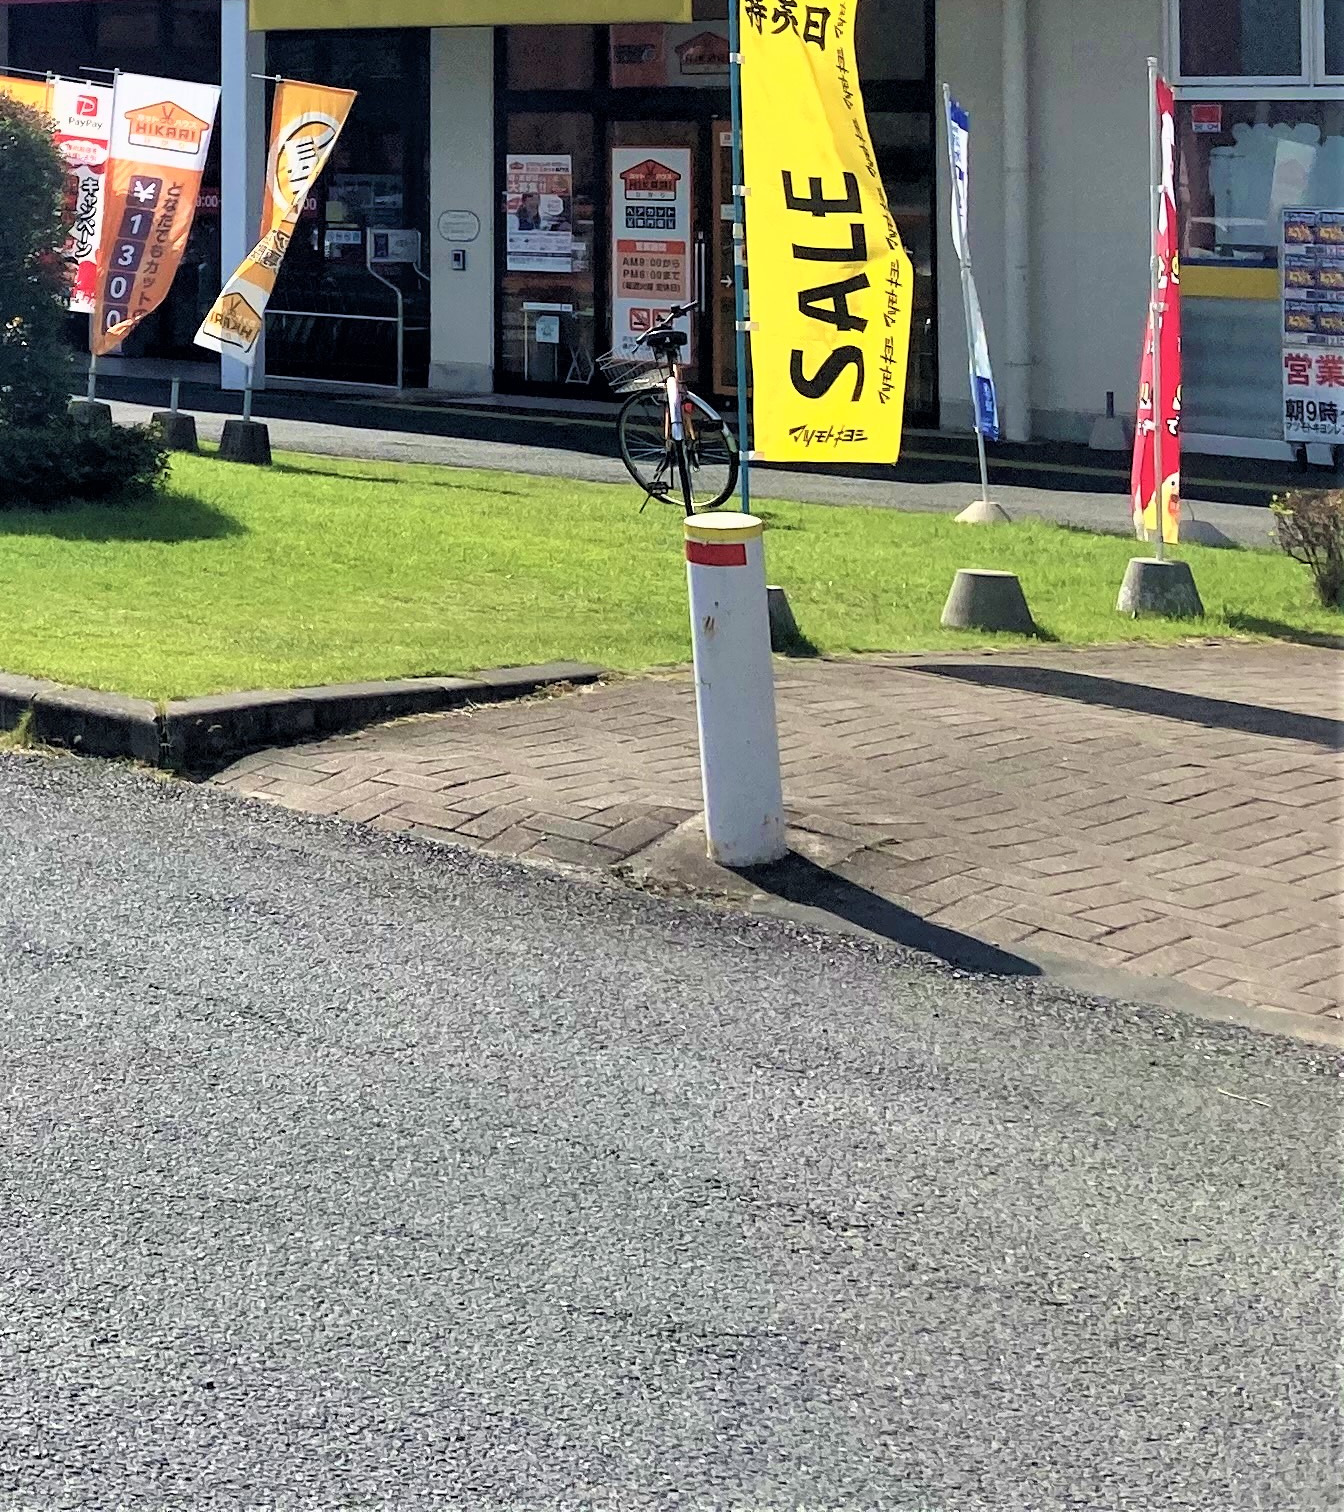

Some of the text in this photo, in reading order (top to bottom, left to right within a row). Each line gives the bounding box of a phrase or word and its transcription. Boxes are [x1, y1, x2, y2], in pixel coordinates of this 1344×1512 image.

[68, 116, 103, 129] PayPay
[135, 122, 196, 141] HIKARI
[75, 176, 100, 258] キャンペーン
[781, 170, 871, 402] SALE
[1286, 398, 1344, 425] 朝9時
[789, 424, 868, 448] マツモトキヨシ
